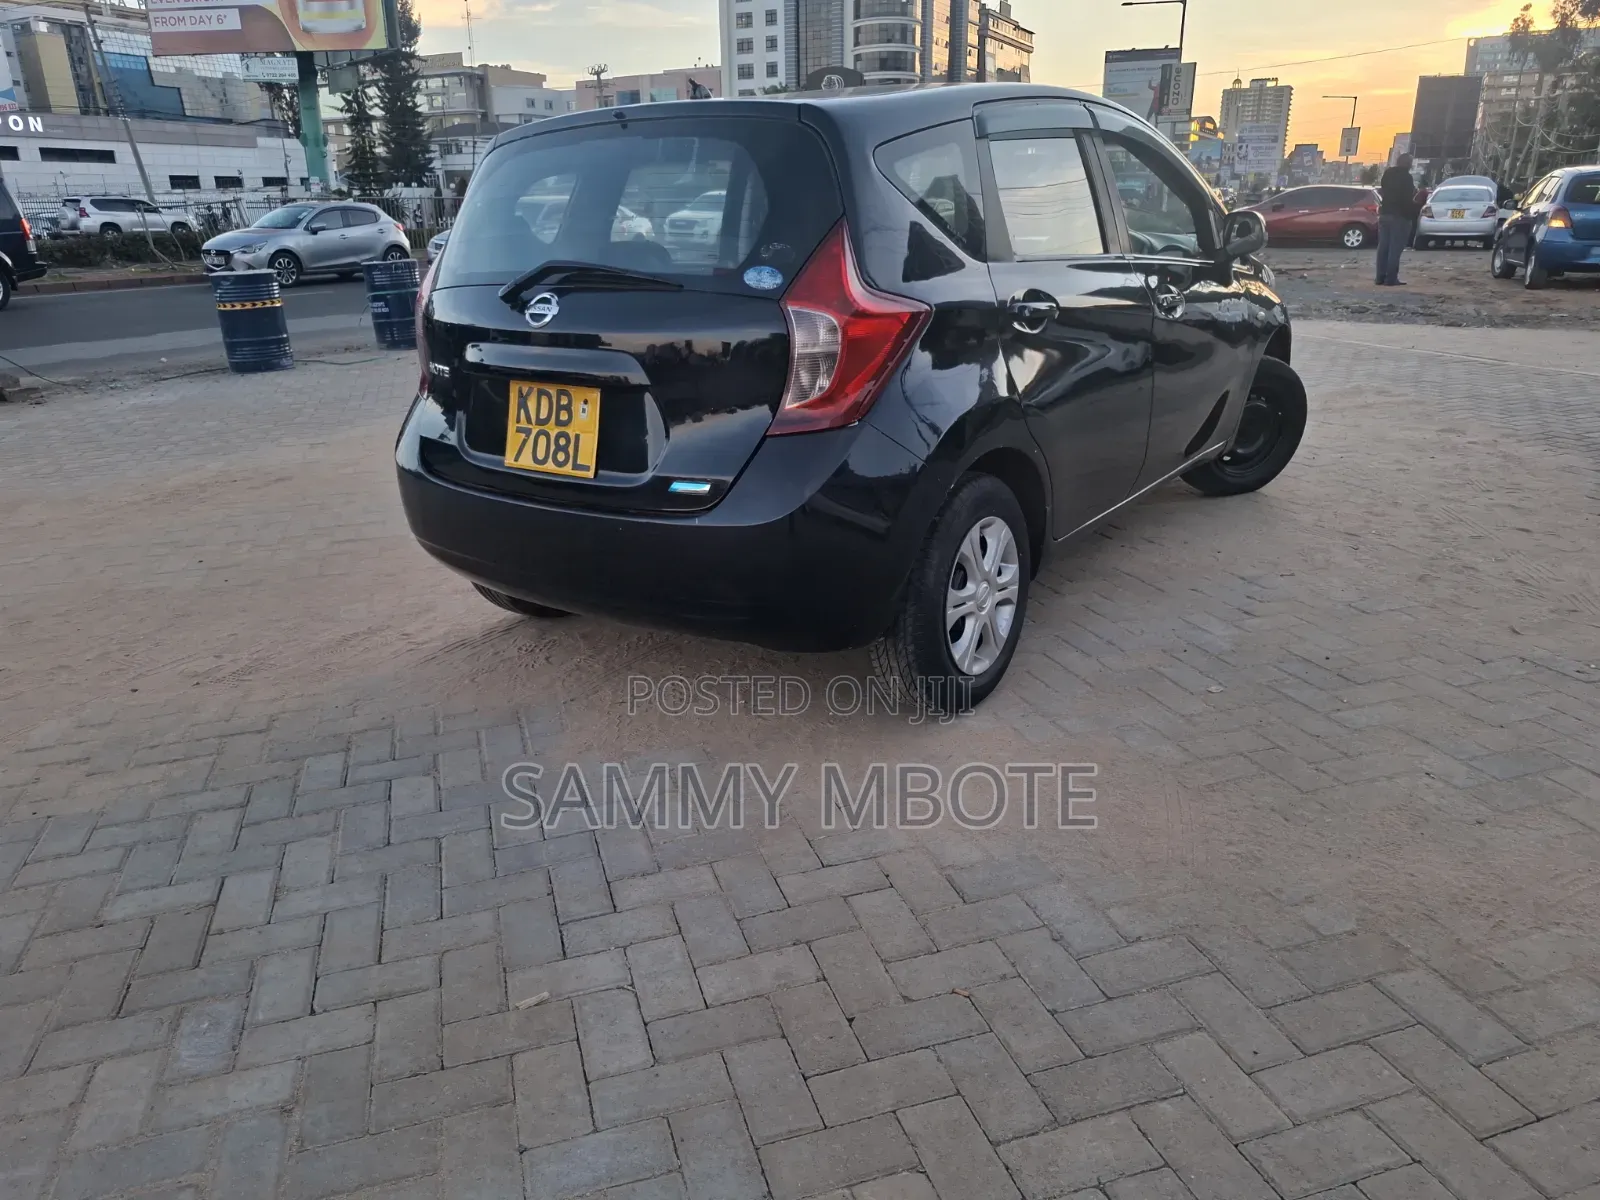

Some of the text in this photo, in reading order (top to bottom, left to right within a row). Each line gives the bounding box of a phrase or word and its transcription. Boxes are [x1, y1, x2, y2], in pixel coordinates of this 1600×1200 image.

[154, 16, 187, 28] FROM
[189, 15, 213, 26] DAY
[0, 115, 44, 133] ON
[429, 361, 450, 378] NOTE
[516, 386, 574, 427] KDB
[513, 426, 591, 472] 708L
